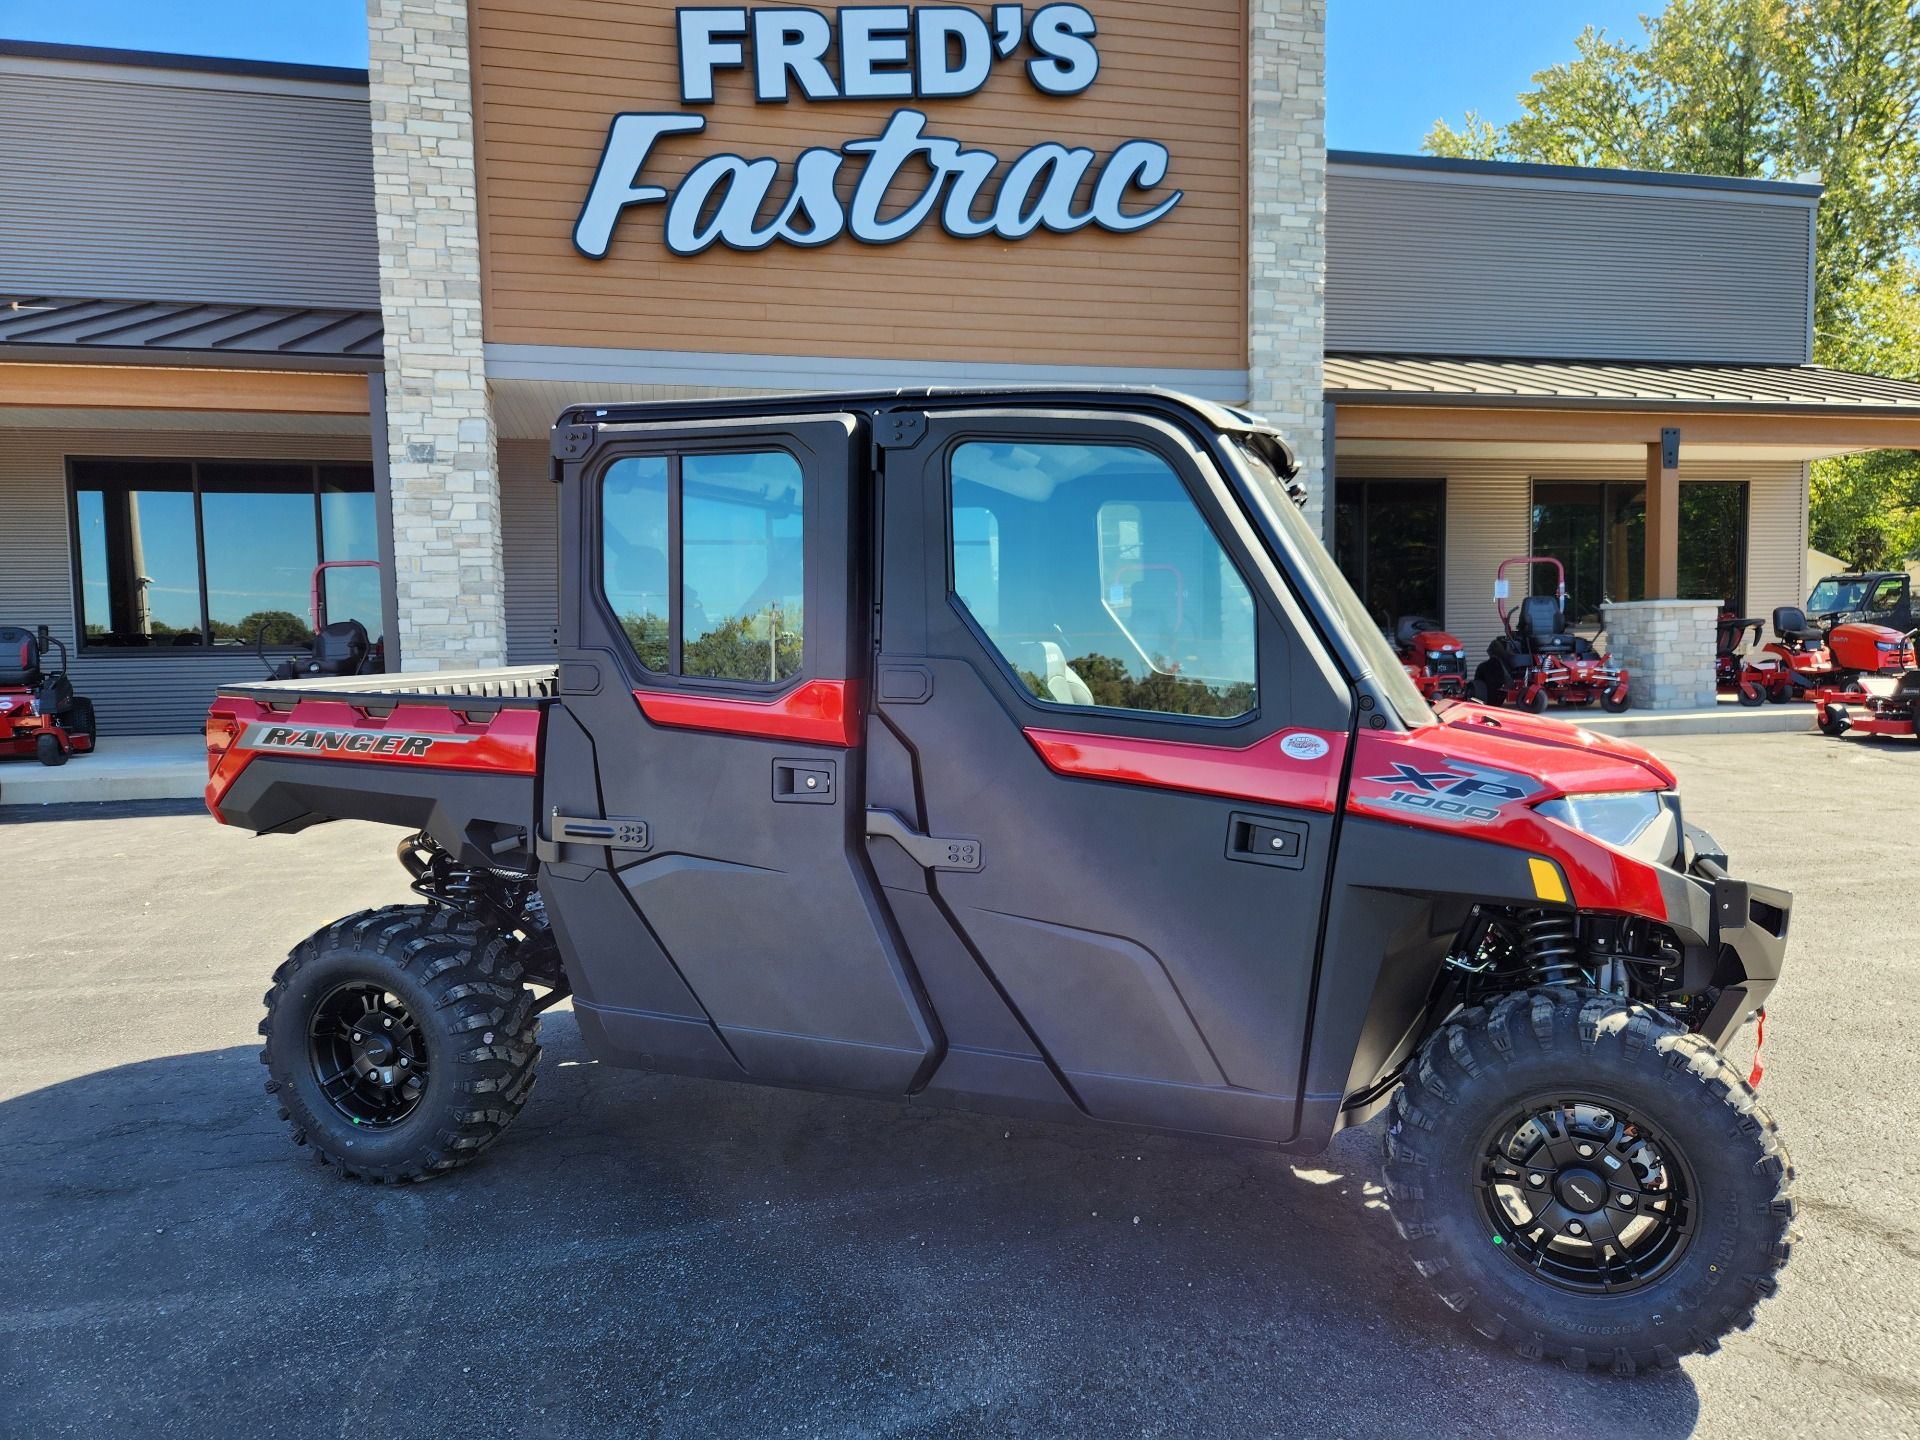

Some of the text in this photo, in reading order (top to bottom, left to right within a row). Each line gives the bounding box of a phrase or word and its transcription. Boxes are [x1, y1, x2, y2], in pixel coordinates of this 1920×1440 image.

[676, 3, 1100, 104] FRED'S
[572, 108, 1183, 259] Fastrac
[262, 727, 434, 756] RANGER
[1361, 762, 1527, 800] XP
[1390, 790, 1500, 820] 1000
